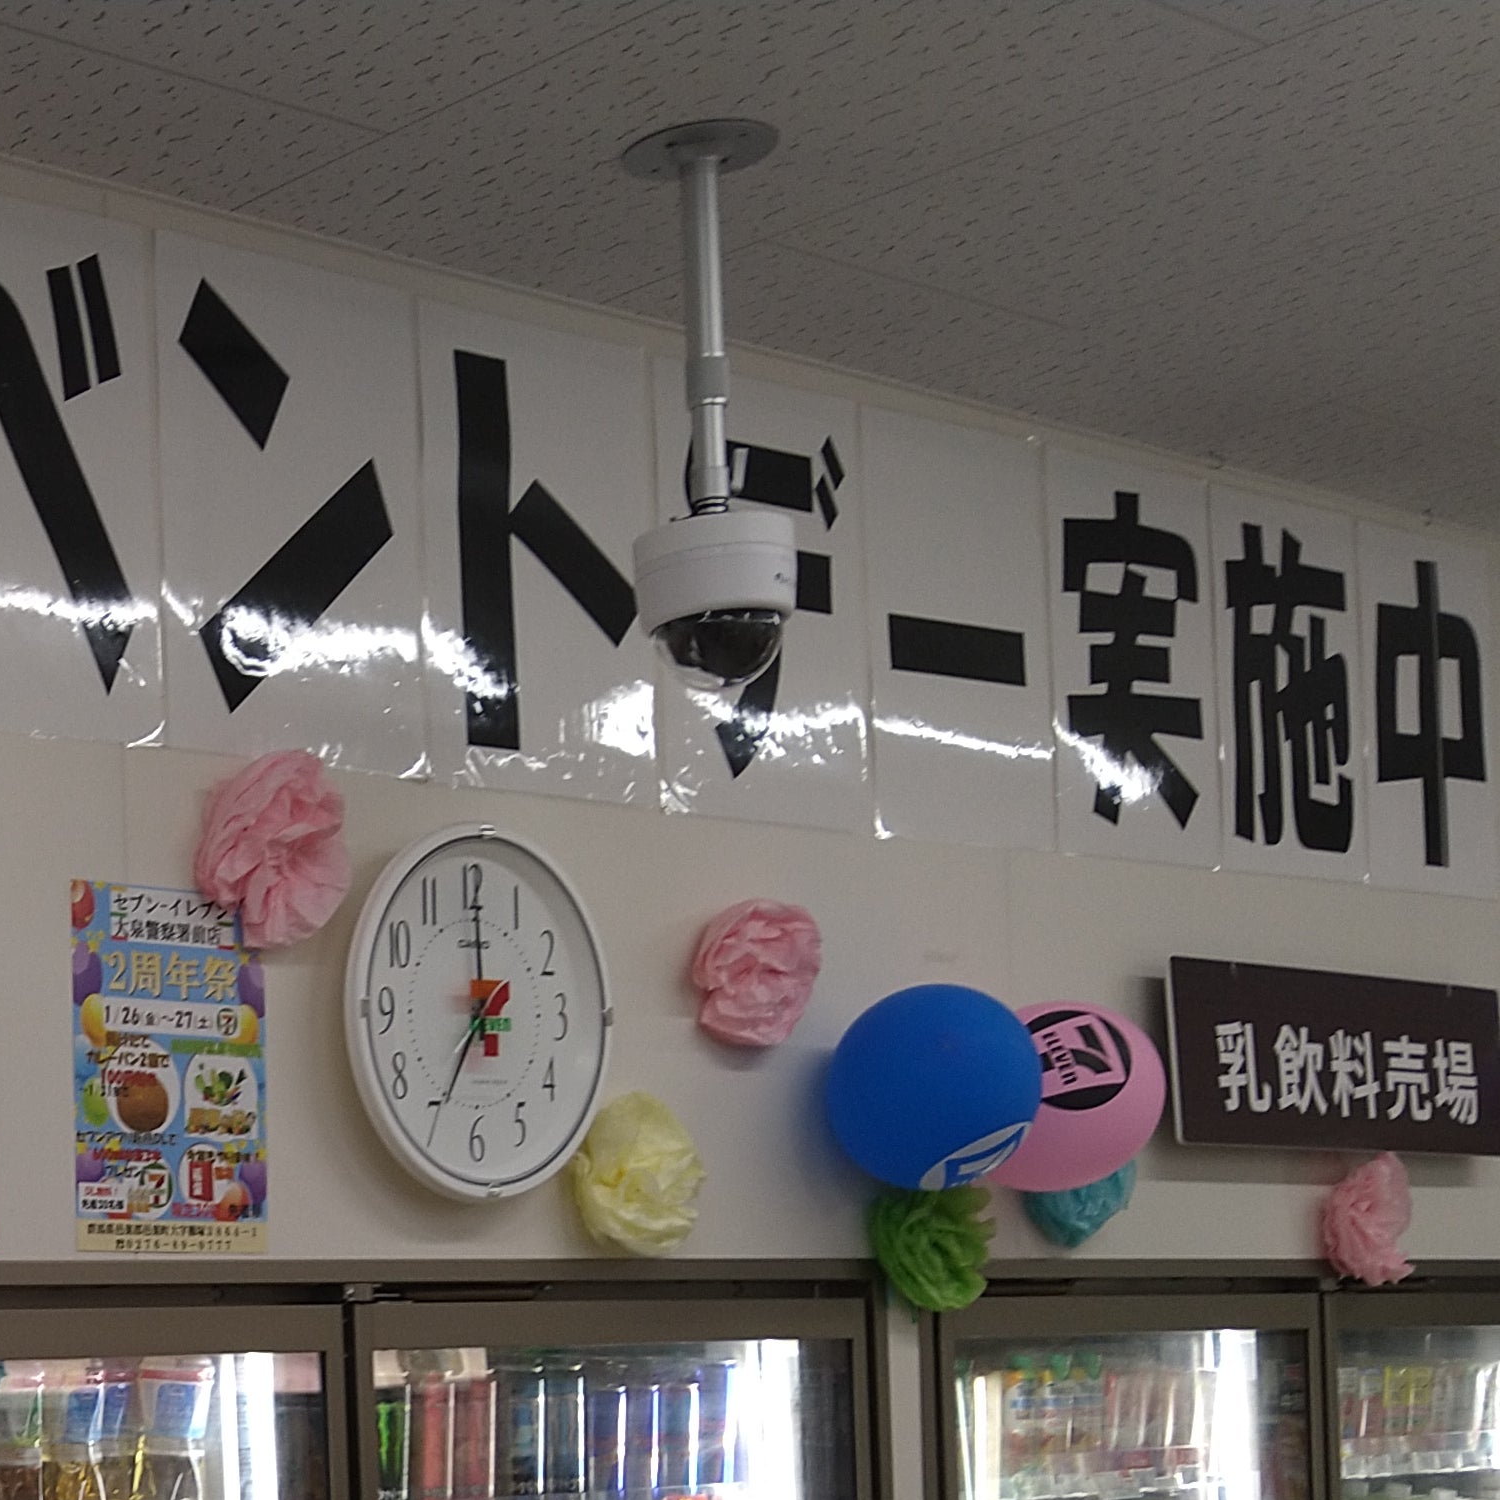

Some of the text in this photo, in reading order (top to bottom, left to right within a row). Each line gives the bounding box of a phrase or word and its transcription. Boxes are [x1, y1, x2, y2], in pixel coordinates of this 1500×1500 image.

[421, 874, 438, 926] 11
[462, 862, 484, 911] 12
[388, 919, 412, 969] 10
[538, 929, 556, 976] 2
[106, 951, 239, 1001] 2周年祭
[377, 985, 397, 1036] 9
[553, 991, 569, 1041] 3
[391, 1051, 409, 1100] 8
[541, 1056, 557, 1102] 4
[1213, 1020, 1480, 1125] 乳飲料売場
[426, 1100, 443, 1148] 7
[468, 1113, 486, 1163] 6
[513, 1101, 527, 1147] 5
